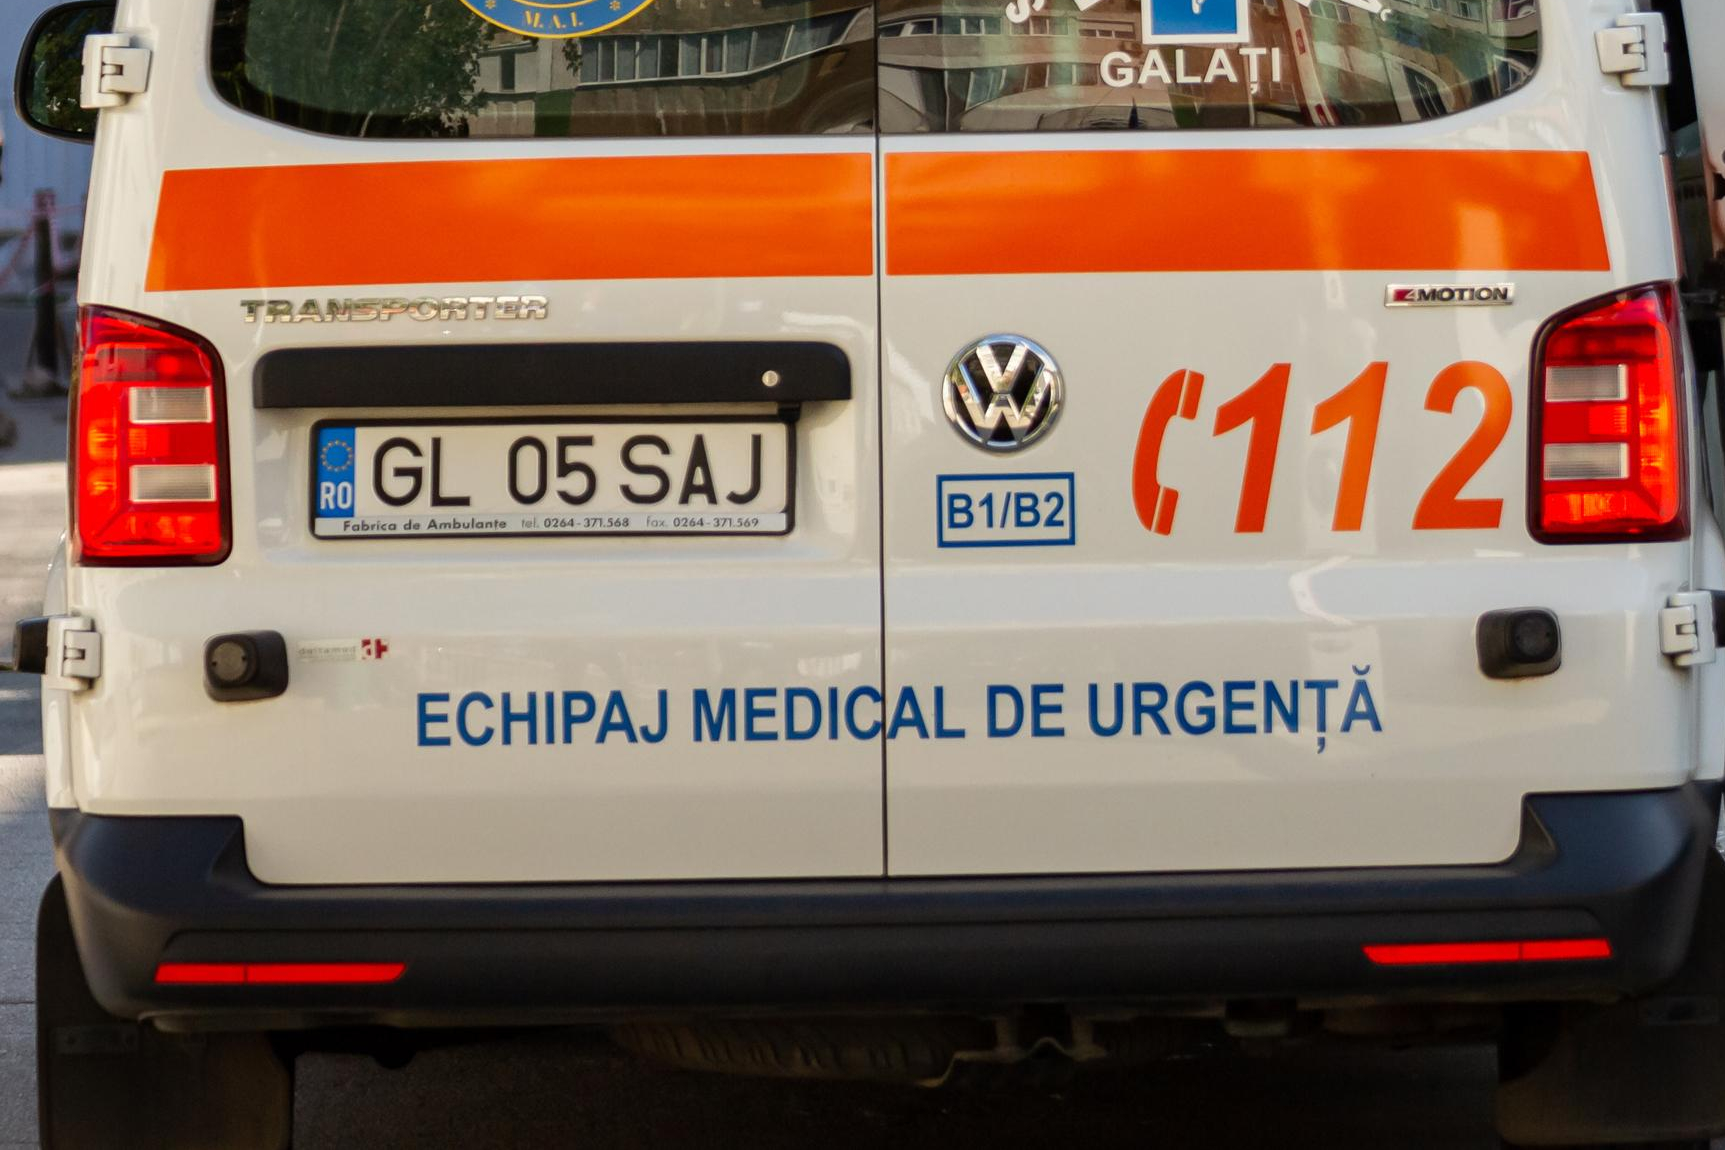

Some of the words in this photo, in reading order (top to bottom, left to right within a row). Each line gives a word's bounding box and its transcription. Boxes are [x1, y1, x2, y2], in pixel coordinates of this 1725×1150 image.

[1100, 48, 1281, 94] GALAȚI
[240, 296, 549, 322] TRANSPORTER
[1213, 361, 1513, 533] 112
[320, 481, 353, 509] RO
[372, 436, 471, 508] GL
[506, 433, 598, 507] 05
[618, 433, 763, 506] SAJ
[343, 520, 397, 531] Fabrica
[404, 519, 421, 530] de
[427, 518, 507, 530] Ambulante
[521, 518, 539, 529] tel.
[948, 491, 1065, 529] B1/B2
[416, 689, 669, 747] ECHIPAJ
[692, 685, 966, 743] MEDICAL
[986, 683, 1065, 739] DE
[1088, 665, 1383, 753] URGENȚĂ
